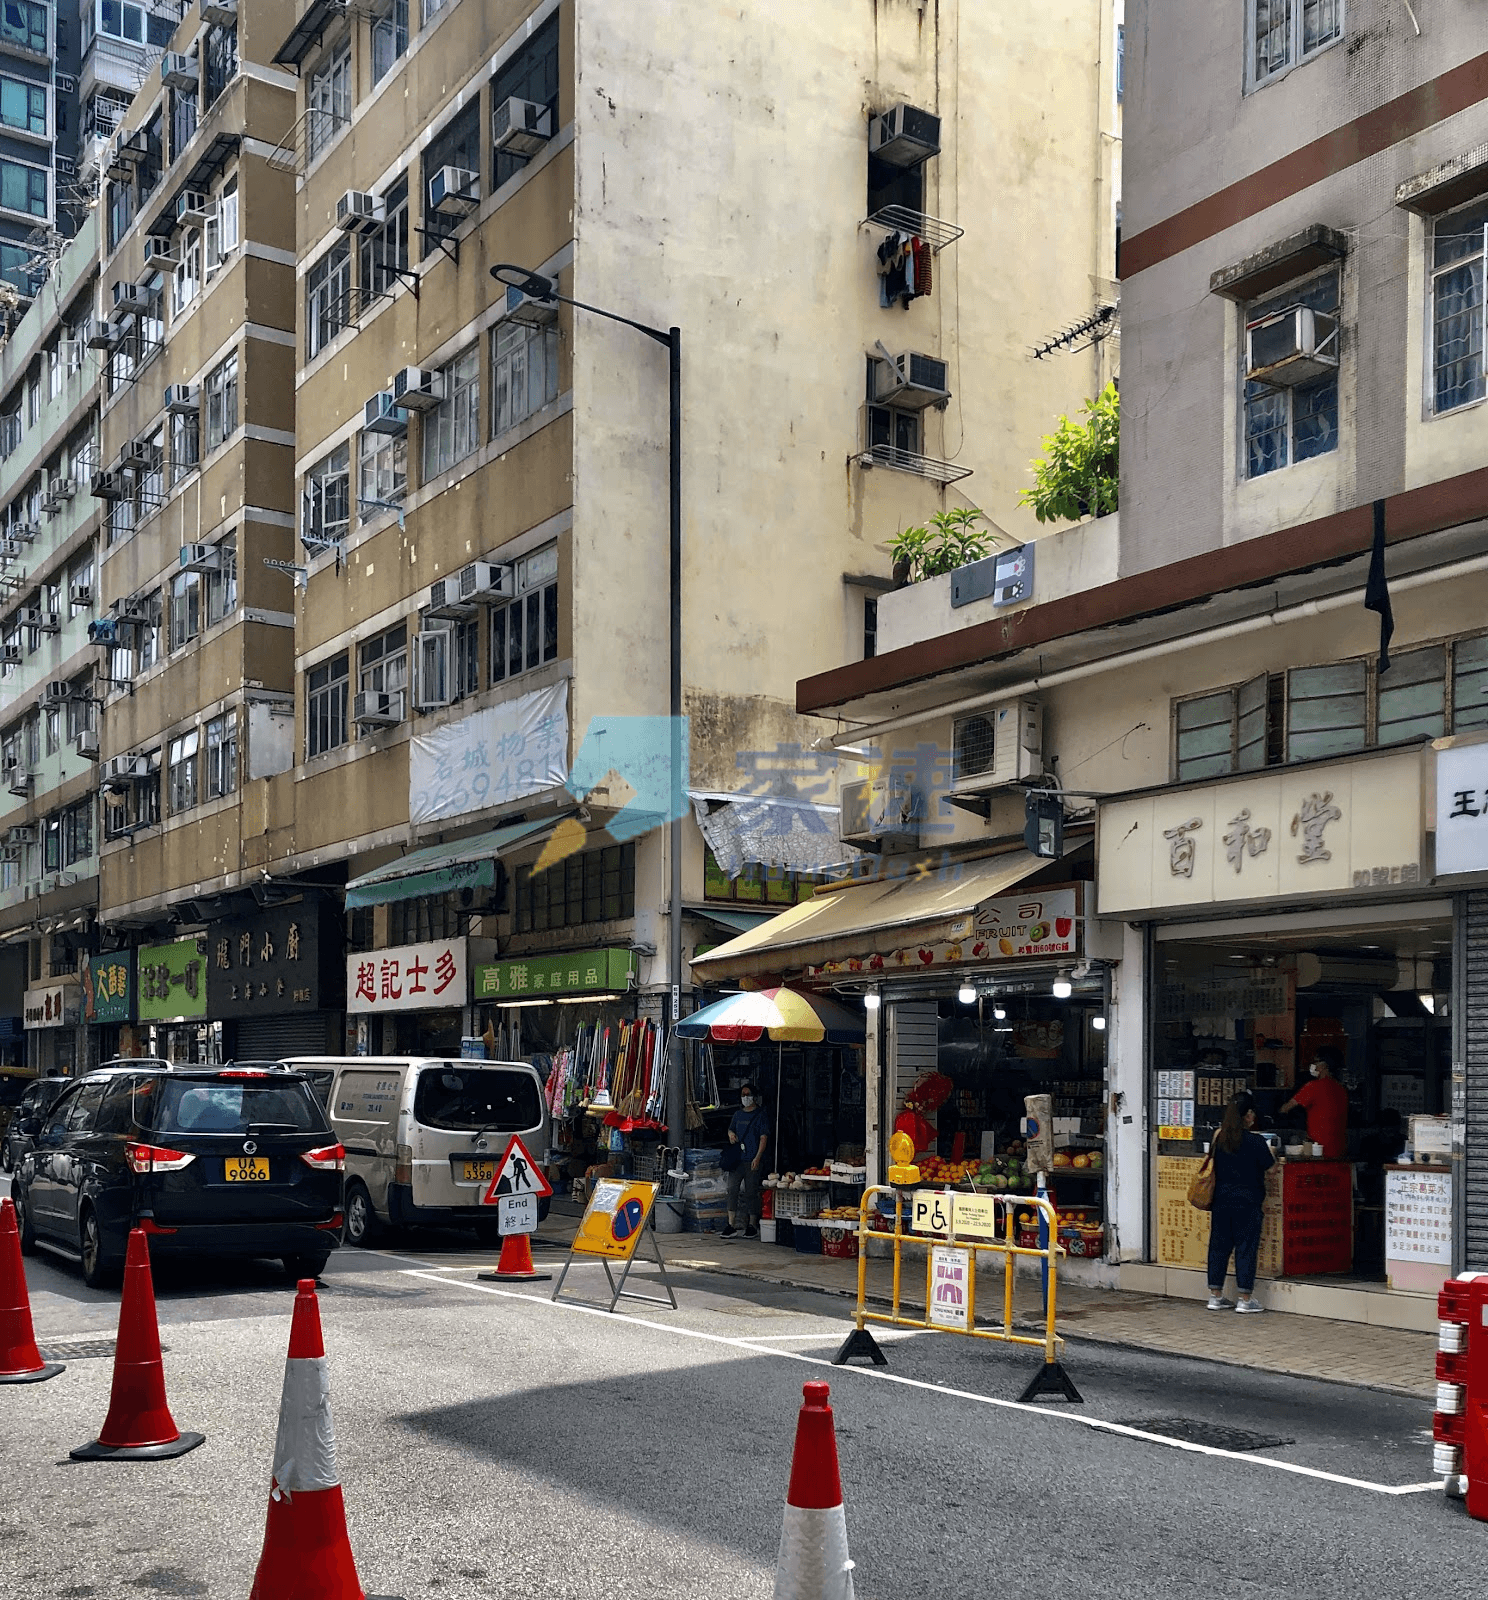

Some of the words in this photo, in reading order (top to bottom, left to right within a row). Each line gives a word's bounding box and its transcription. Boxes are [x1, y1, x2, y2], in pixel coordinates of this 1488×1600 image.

[1450, 789, 1488, 818] 王
[1162, 790, 1342, 878] 百和堂
[975, 902, 1043, 924] 公司
[976, 925, 1027, 940] FRUIT
[355, 949, 457, 1003] 超記士多
[482, 964, 528, 993] 高雅
[533, 968, 598, 989] 家庭用品
[238, 1159, 256, 1169] UA
[472, 1162, 486, 1171] RF
[229, 1169, 266, 1180] 9066
[466, 1170, 492, 1180] 3398
[1400, 1181, 1446, 1195] 正宗葛菜水
[508, 1199, 528, 1209] End
[917, 1203, 927, 1221] P
[505, 1214, 531, 1228] 終止
